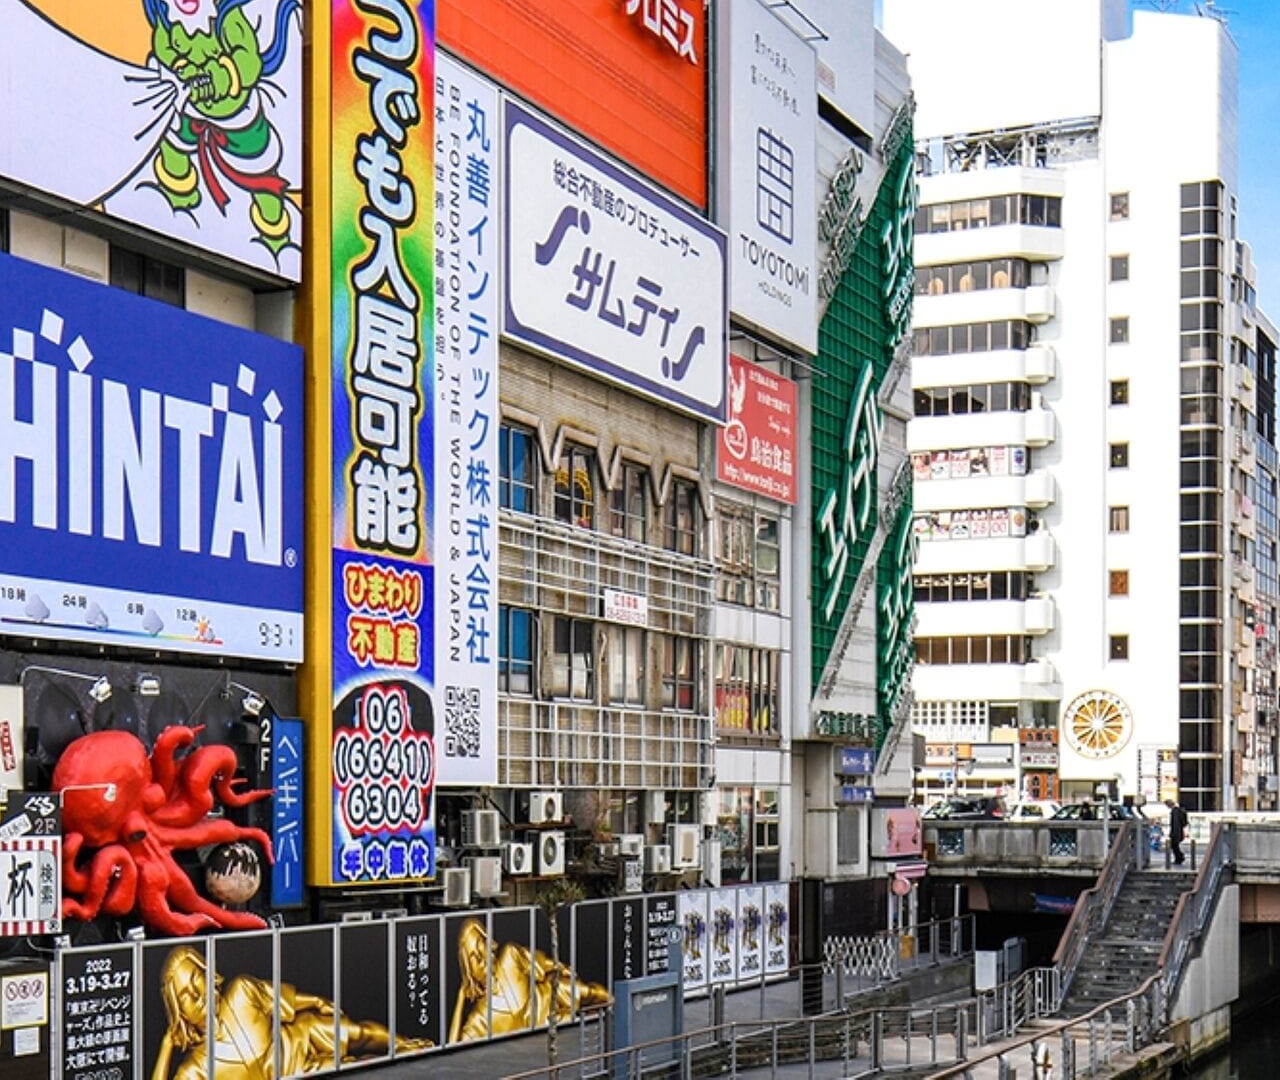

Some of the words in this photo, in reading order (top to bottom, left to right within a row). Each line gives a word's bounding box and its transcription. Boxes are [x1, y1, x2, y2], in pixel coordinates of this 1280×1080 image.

[449, 84, 461, 121] BE
[449, 132, 461, 313] FOUNDATION
[553, 158, 701, 260] 総合不動産のプロデューサー
[566, 246, 680, 348] サムティ
[449, 323, 461, 363] OF
[449, 373, 461, 424] THE
[465, 98, 491, 665] 丸善インテック株式会社
[449, 436, 462, 536] WORLD
[346, 562, 422, 617] ひまわり
[349, 617, 420, 669] 不動産
[449, 573, 462, 663] JAPAN
[365, 692, 402, 735] 06
[261, 718, 271, 771] 2F
[334, 734, 432, 789] (6641)
[34, 818, 57, 834] 2F
[277, 735, 299, 889] ペンギンバー
[346, 786, 421, 828] 6304
[340, 840, 430, 882] 年中無休
[66, 971, 130, 994] 3.19-3.27
[86, 959, 112, 973] 2022
